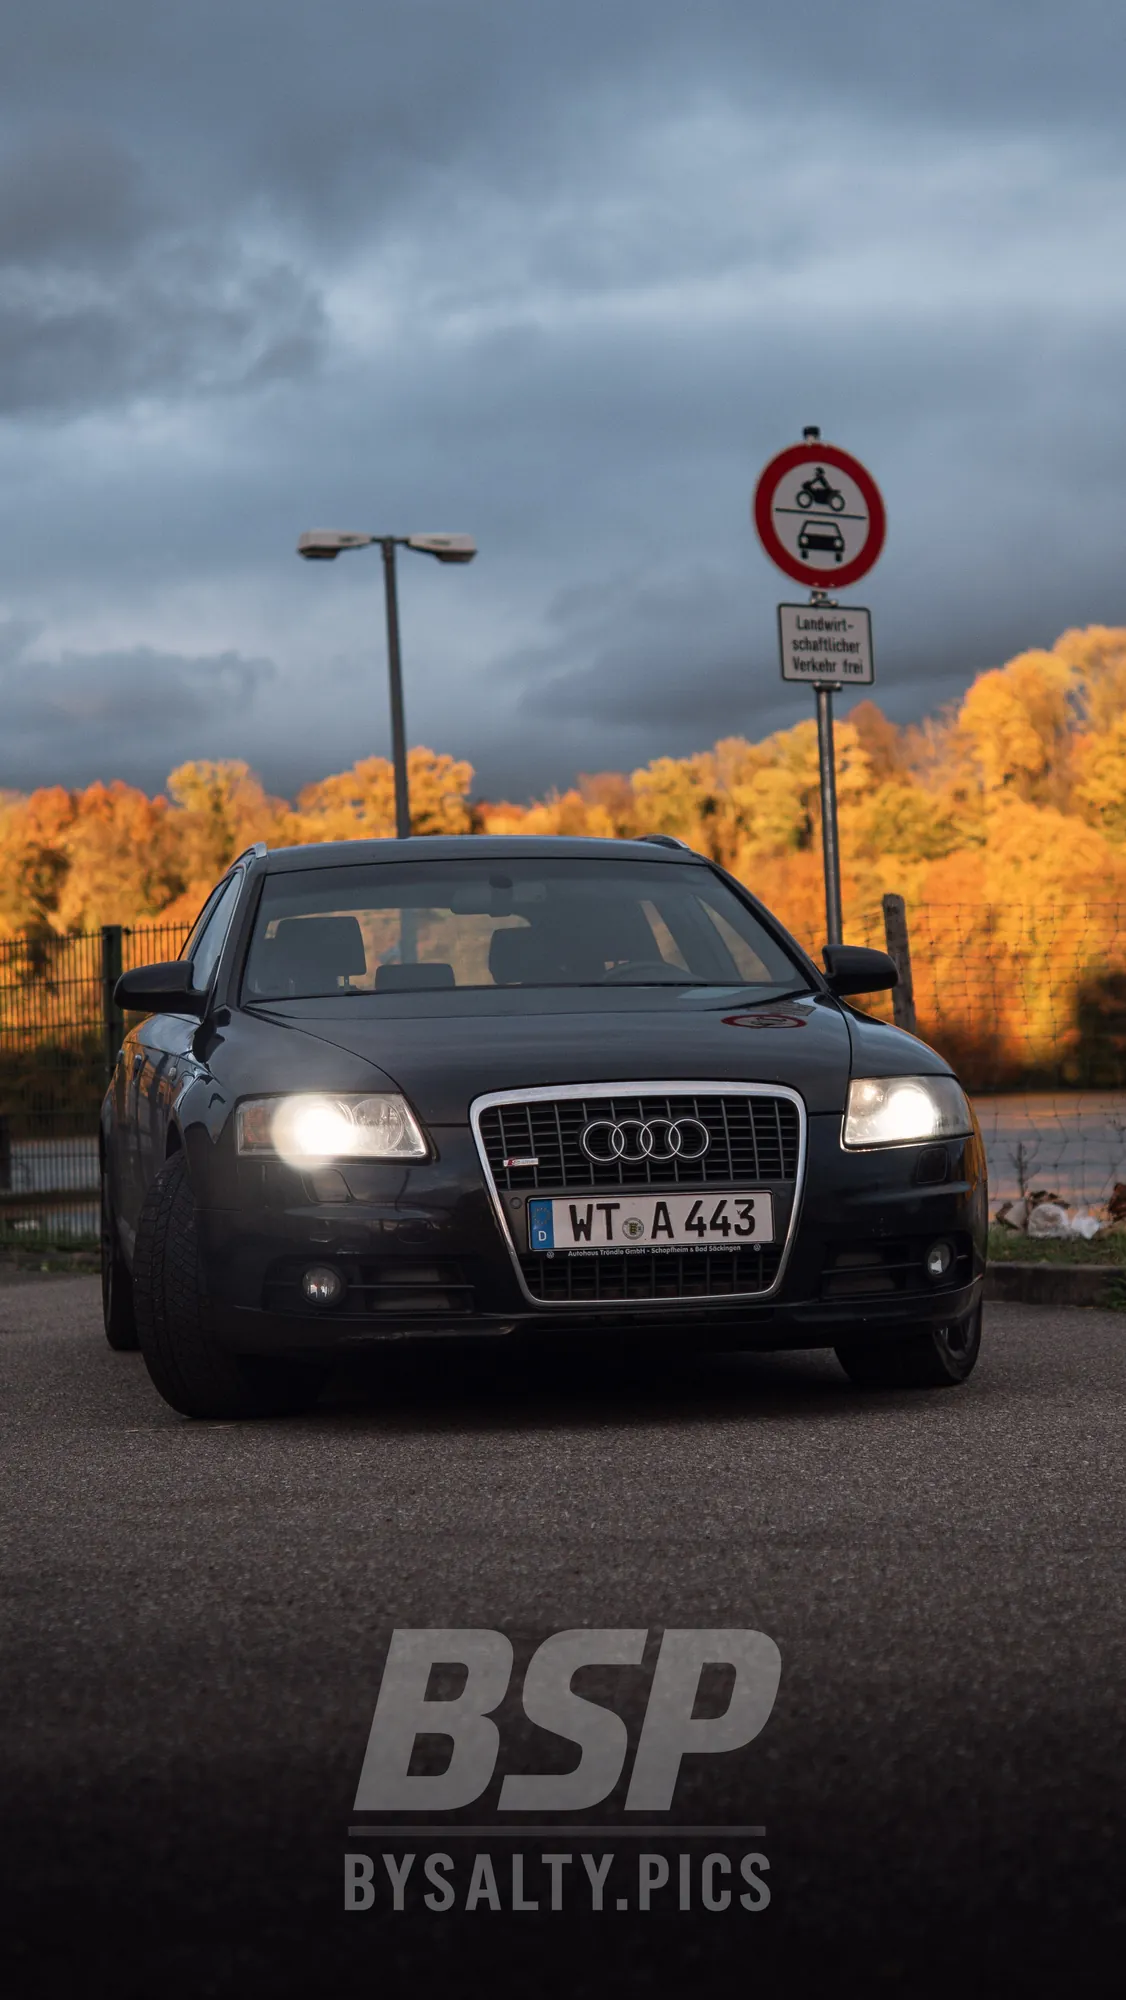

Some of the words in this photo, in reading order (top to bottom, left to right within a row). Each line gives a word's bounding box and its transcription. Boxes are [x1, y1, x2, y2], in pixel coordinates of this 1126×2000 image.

[796, 615, 854, 632] Landwirt-
[792, 636, 860, 654] schaftlicher
[792, 656, 837, 672] Verkehr
[842, 658, 863, 674] frei
[569, 1202, 620, 1241] WT
[651, 1201, 674, 1239] A
[685, 1199, 756, 1237] 443
[538, 1231, 547, 1241] D
[625, 1247, 645, 1255] GmbH
[651, 1246, 688, 1254] Schopfheim
